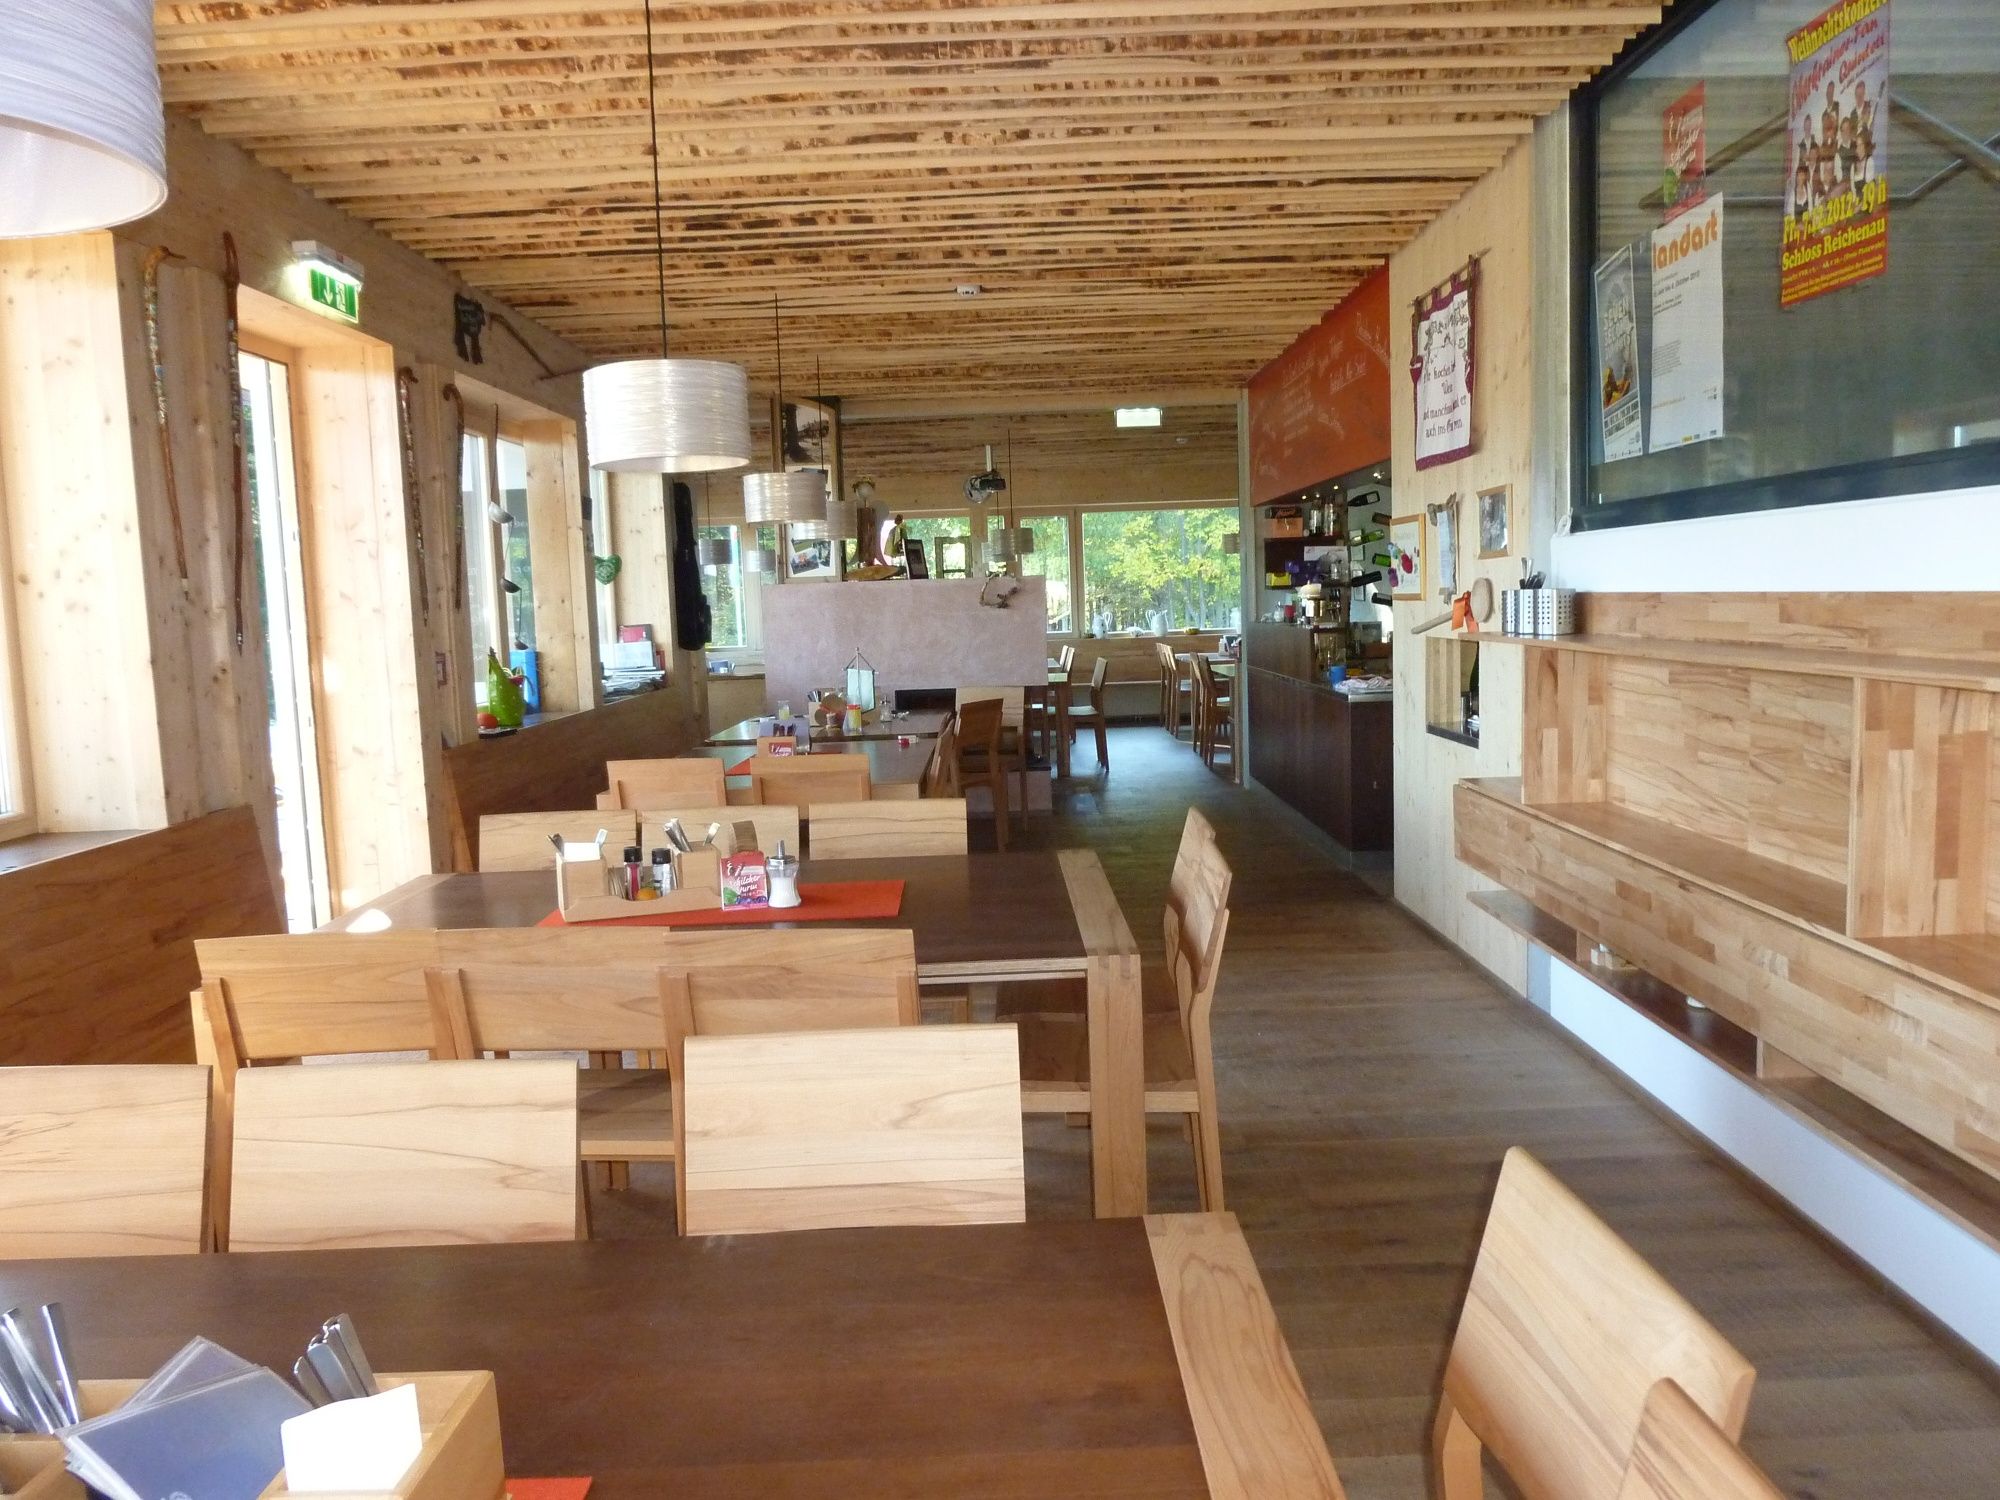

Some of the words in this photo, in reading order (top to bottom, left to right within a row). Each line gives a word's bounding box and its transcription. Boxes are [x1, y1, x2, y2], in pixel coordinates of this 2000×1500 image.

[1788, 0, 1887, 65] Weihnachtskonzer
[1653, 208, 1718, 272] landart
[1782, 243, 1822, 272] Schloss
[1823, 217, 1886, 256] Reichenau
